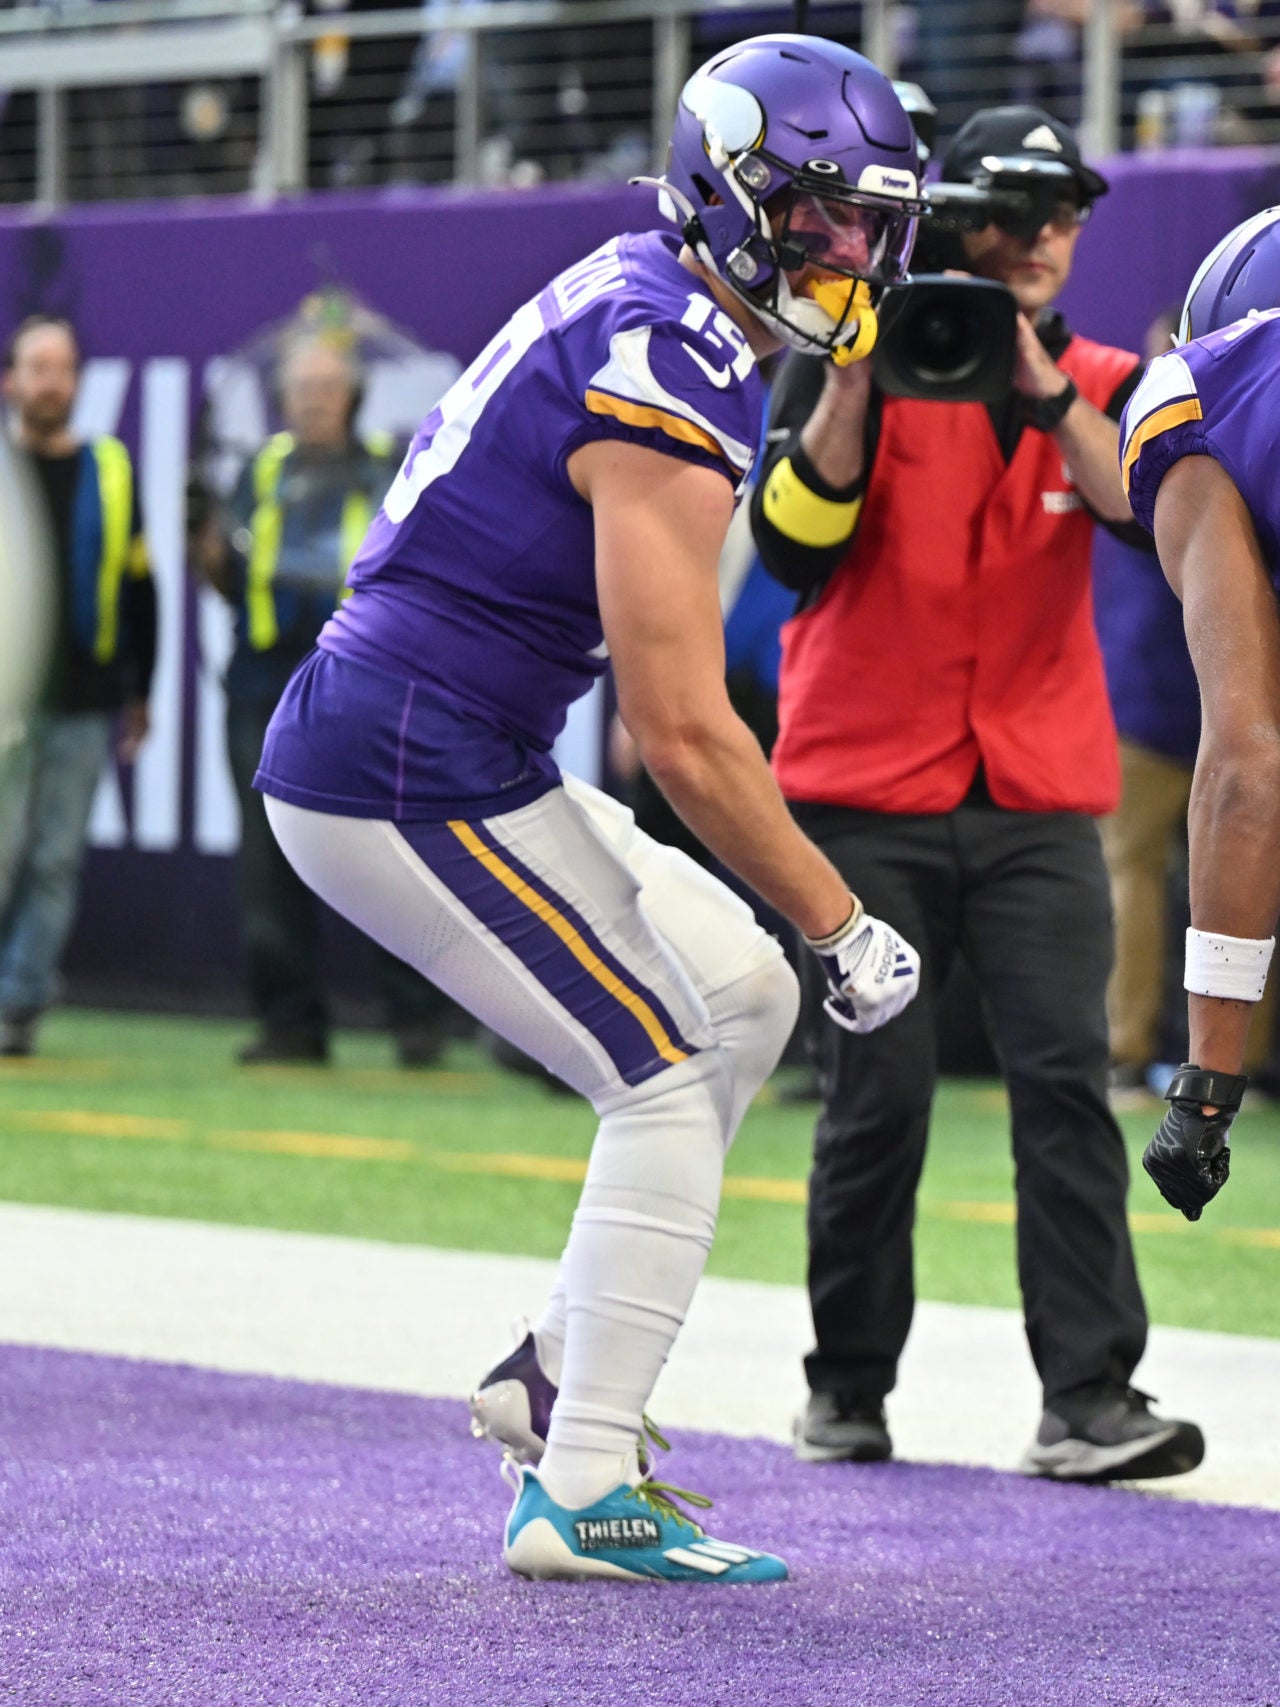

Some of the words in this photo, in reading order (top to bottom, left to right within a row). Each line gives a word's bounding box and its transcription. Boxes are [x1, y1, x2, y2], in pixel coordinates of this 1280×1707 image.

[680, 292, 757, 382] 19
[874, 930, 896, 985] adidas
[575, 1518, 659, 1541] THIELEN
